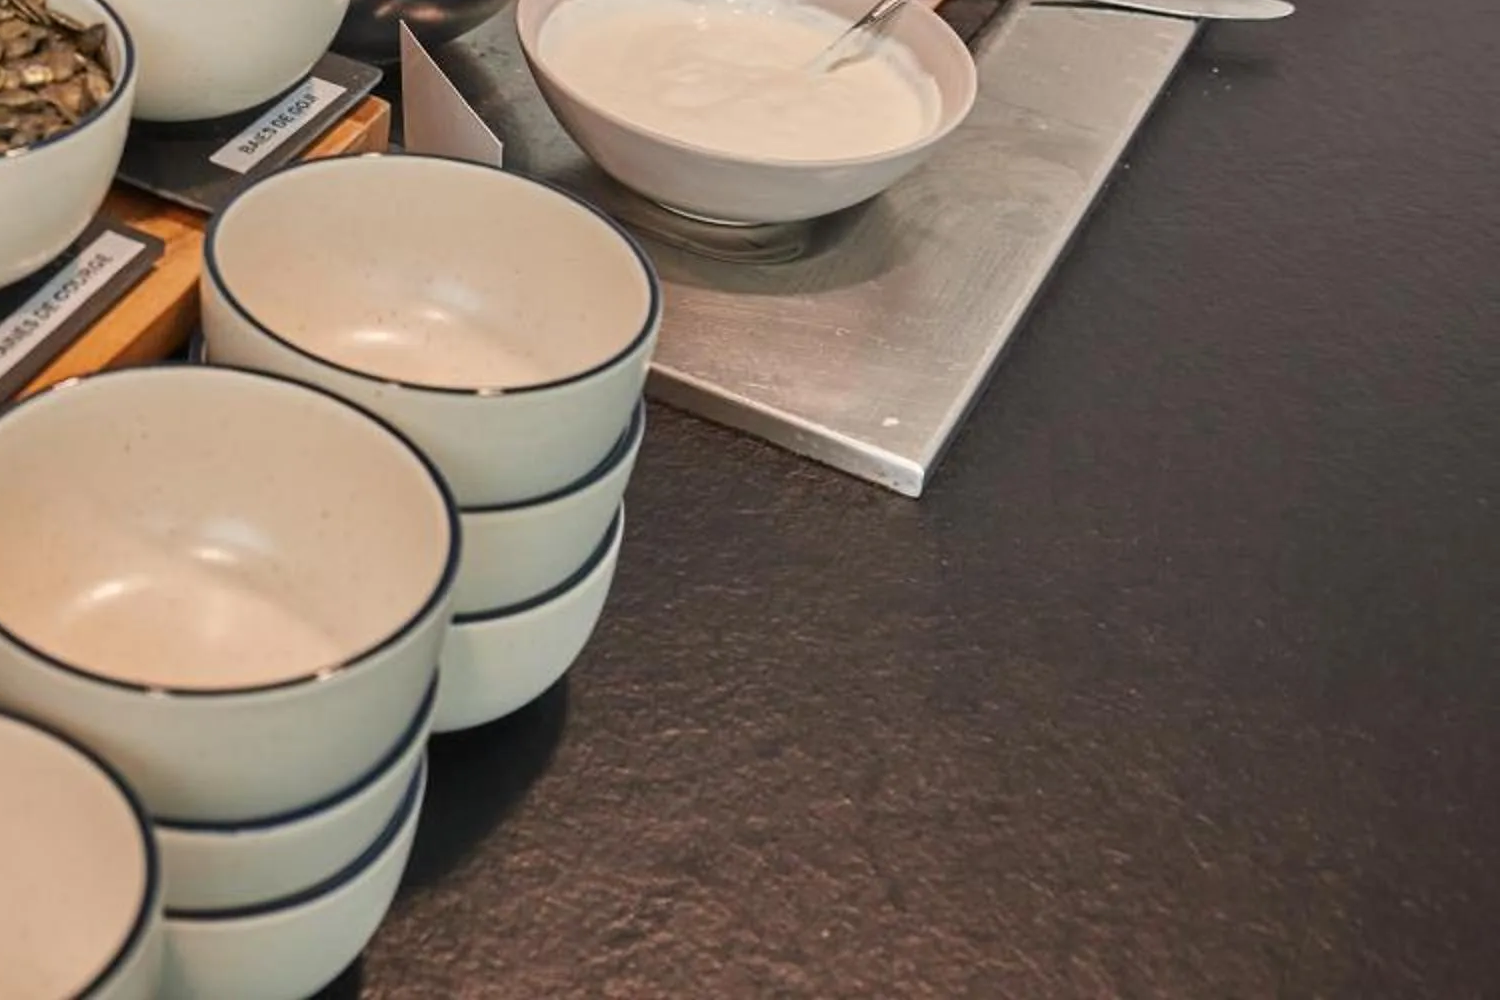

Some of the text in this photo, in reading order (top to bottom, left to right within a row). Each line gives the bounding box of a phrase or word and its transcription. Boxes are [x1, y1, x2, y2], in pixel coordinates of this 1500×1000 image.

[238, 126, 276, 155] BAIES
[271, 113, 294, 128] DE
[34, 301, 60, 320] DE
[53, 252, 114, 300] COURGE
